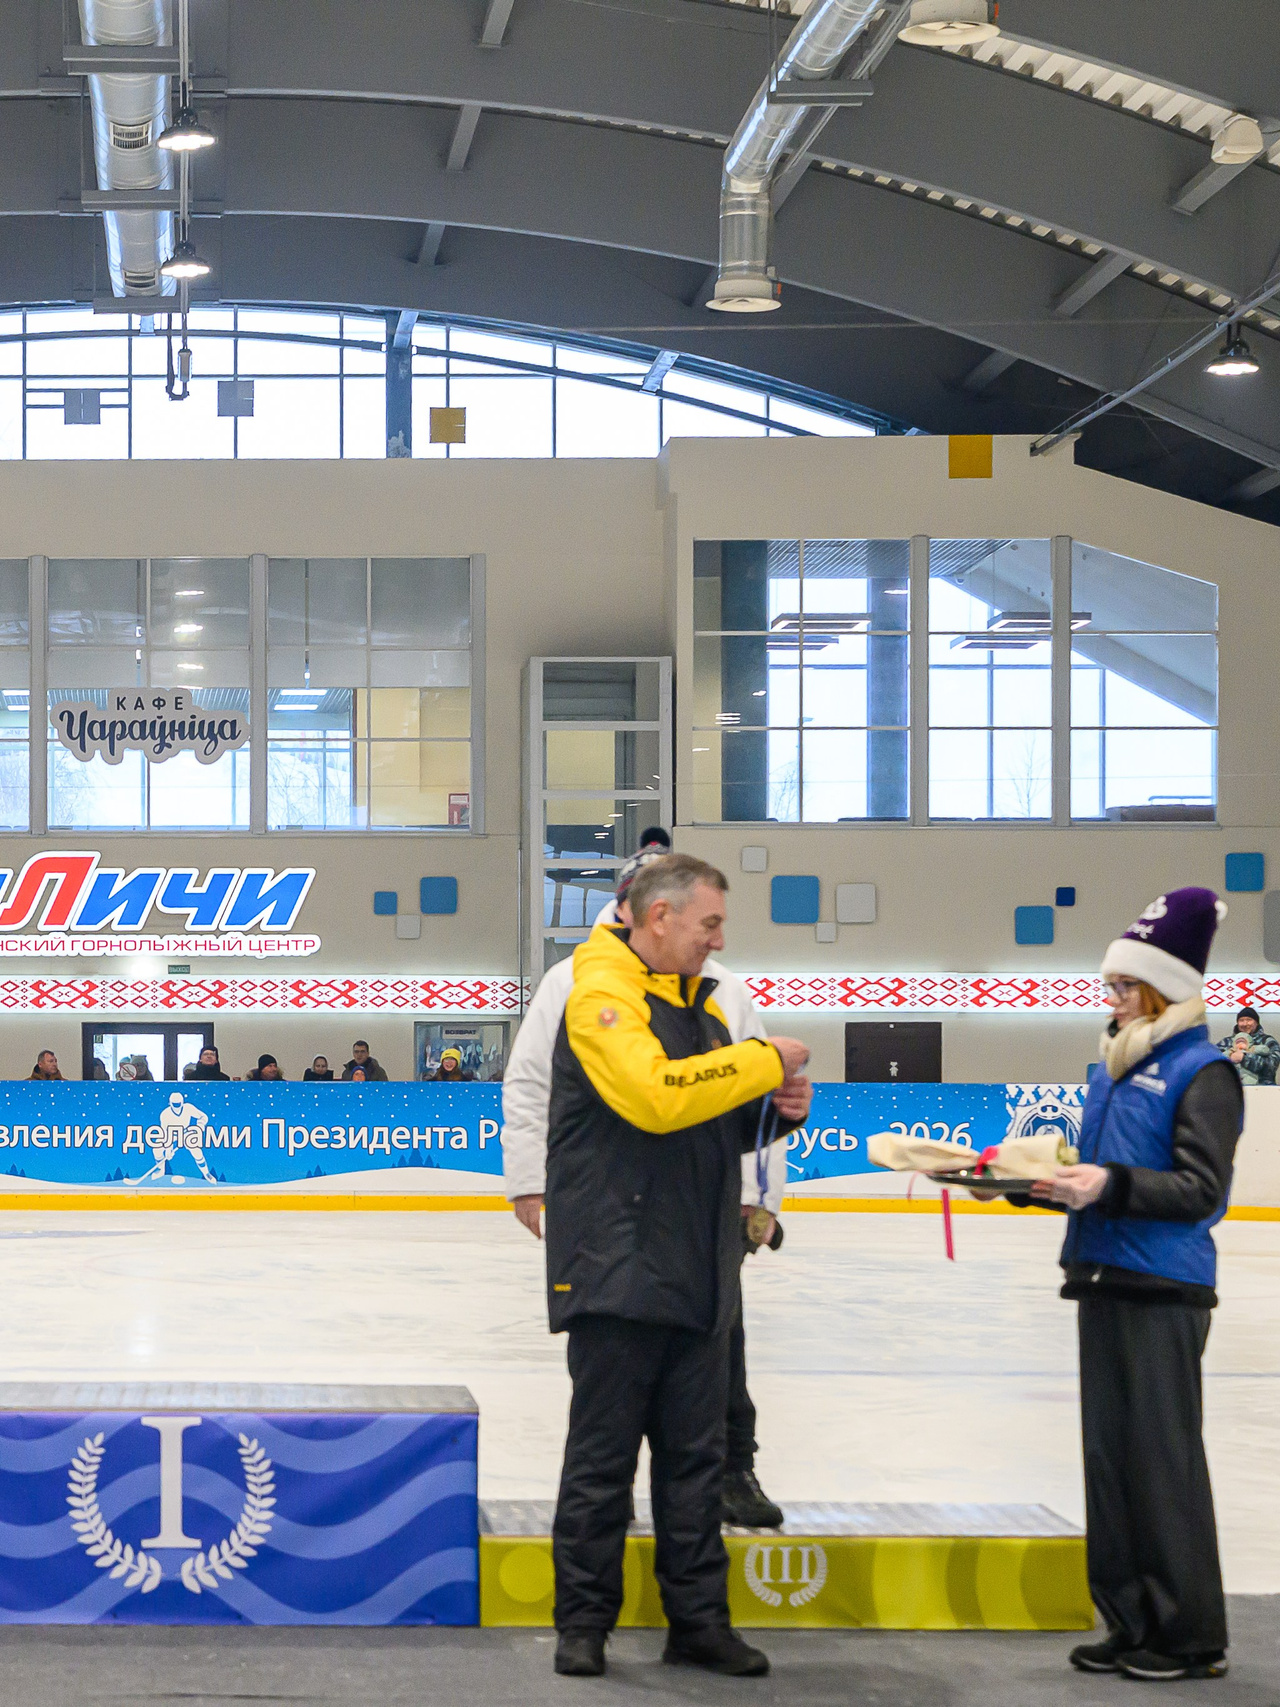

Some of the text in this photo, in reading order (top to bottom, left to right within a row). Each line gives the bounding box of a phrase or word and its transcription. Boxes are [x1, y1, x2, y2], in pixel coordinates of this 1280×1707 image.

[116, 696, 184, 710] КАФЕ
[59, 709, 242, 756] Чараўніца
[71, 936, 243, 952] ГОРНОЛЫЖНЫЙ
[248, 939, 316, 955] ЦЕНТР
[121, 1124, 252, 1155] делами
[261, 1117, 470, 1157] Президента
[759, 1546, 814, 1584] III
